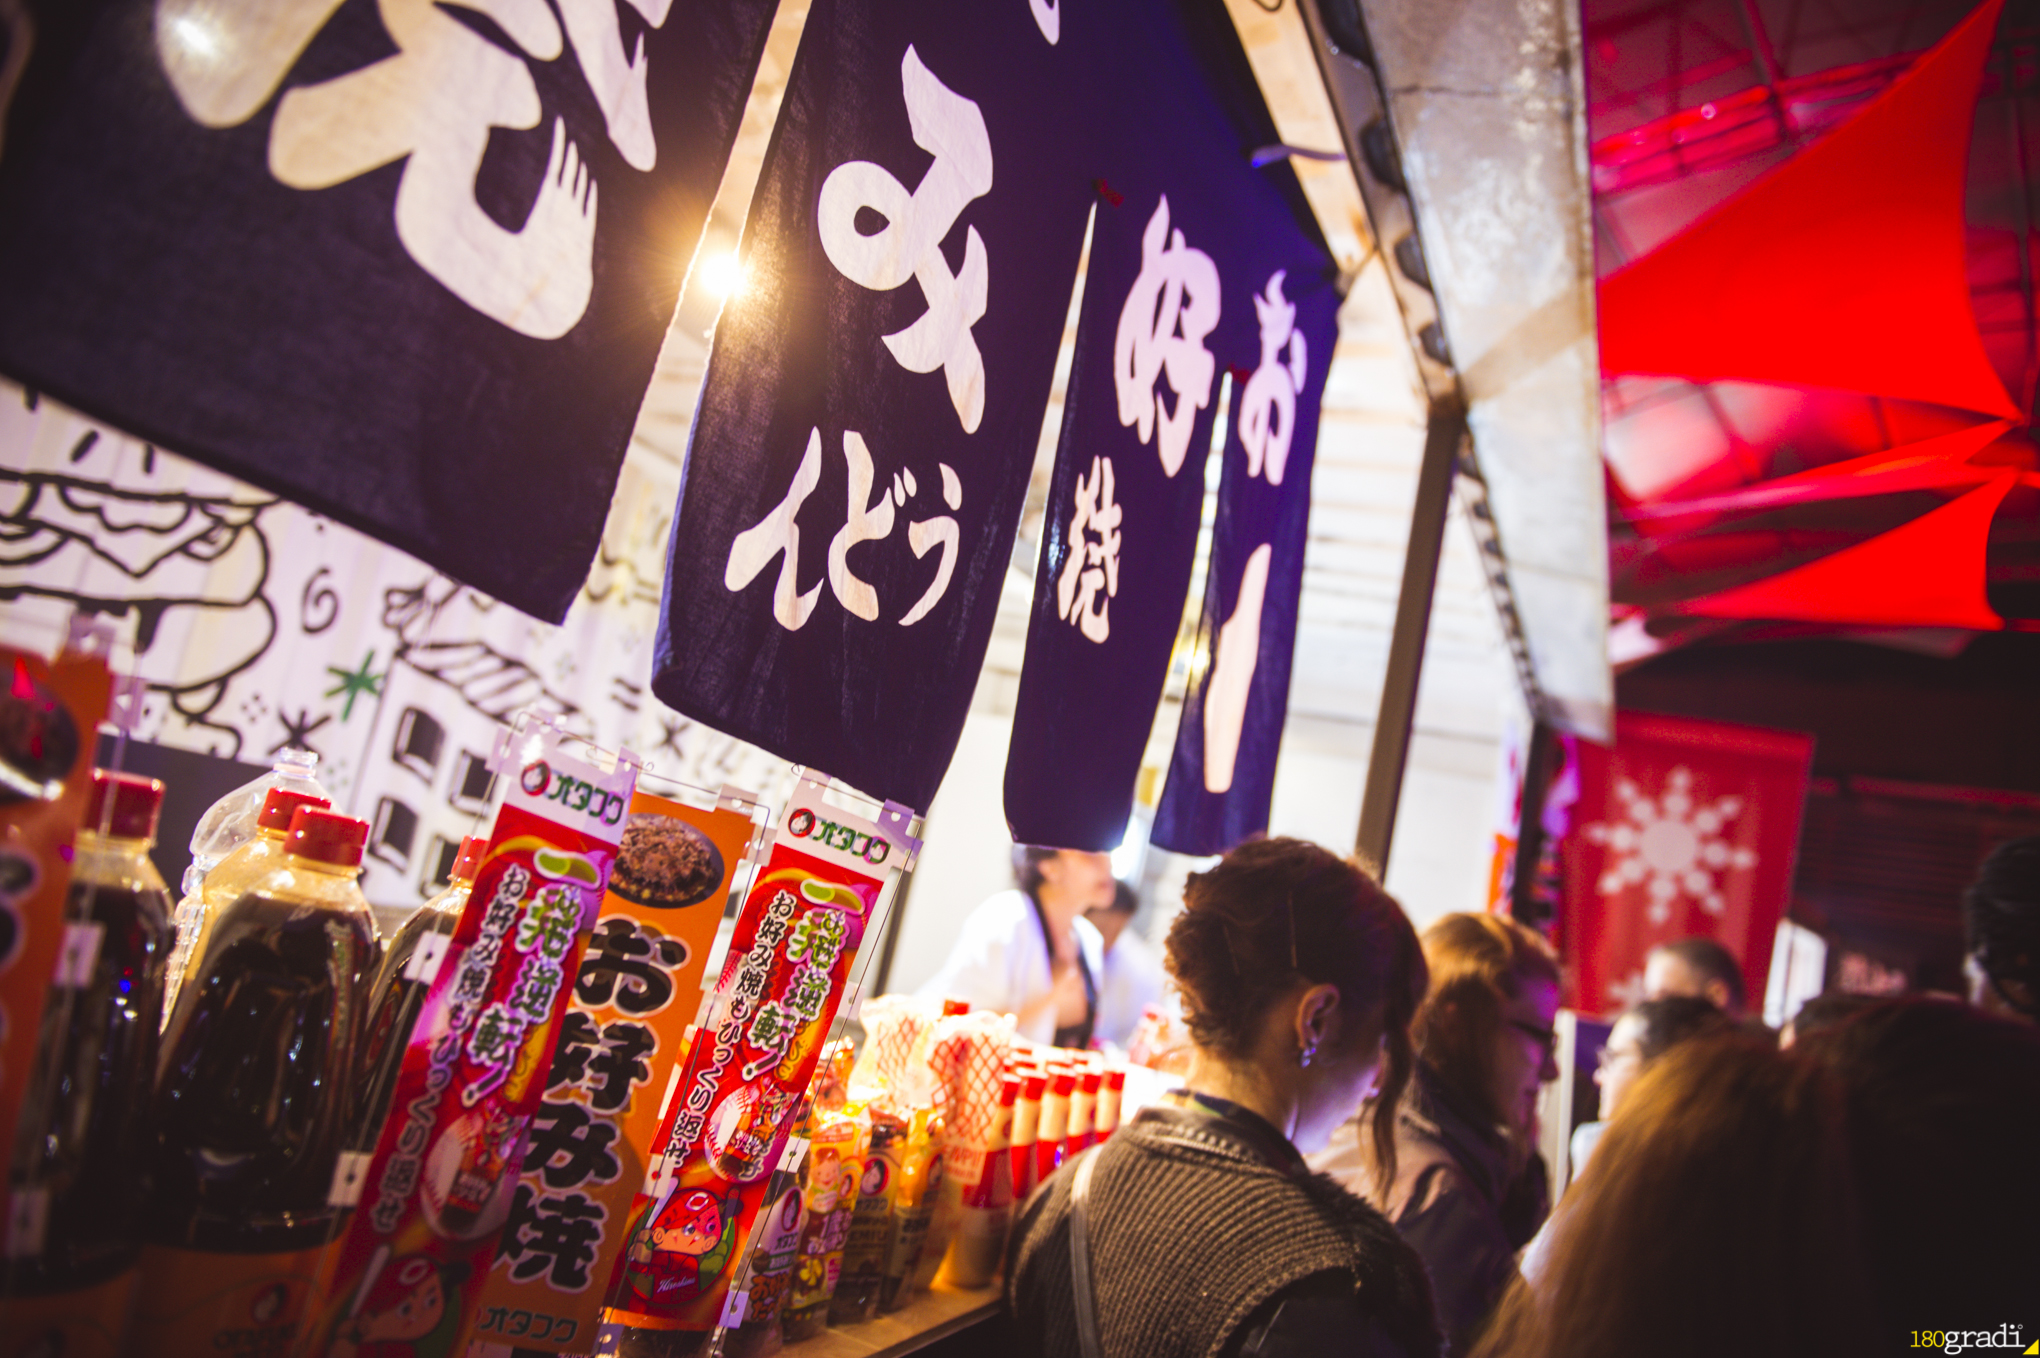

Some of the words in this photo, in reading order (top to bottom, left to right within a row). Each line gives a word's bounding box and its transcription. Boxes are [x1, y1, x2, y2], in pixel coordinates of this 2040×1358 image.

[812, 814, 892, 864] オタフク
[480, 1305, 579, 1344] オタフク
